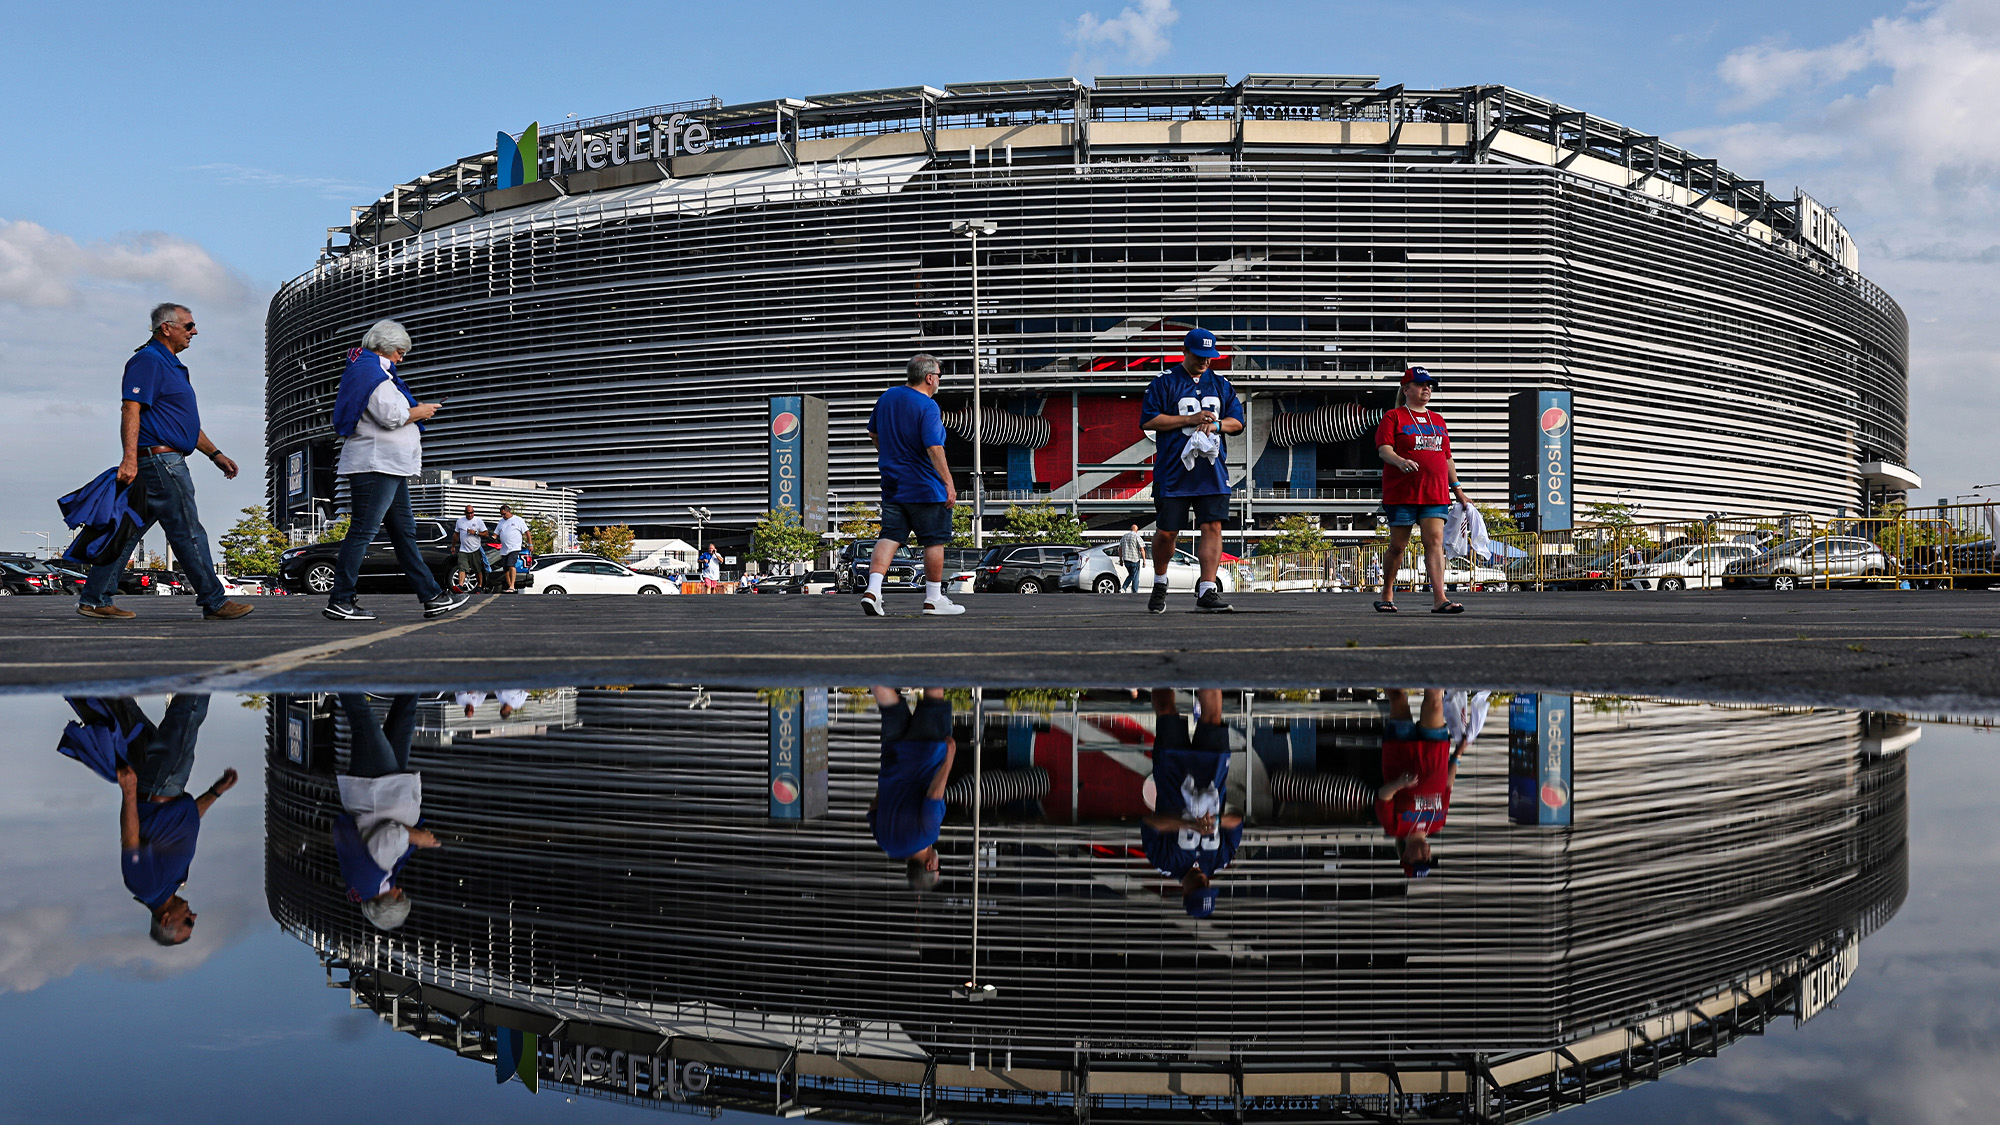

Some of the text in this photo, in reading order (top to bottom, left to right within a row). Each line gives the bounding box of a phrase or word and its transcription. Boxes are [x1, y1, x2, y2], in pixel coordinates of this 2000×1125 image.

[553, 113, 709, 175] MetLife
[776, 446, 796, 507] pepsi
[1544, 444, 1566, 505] pepsi
